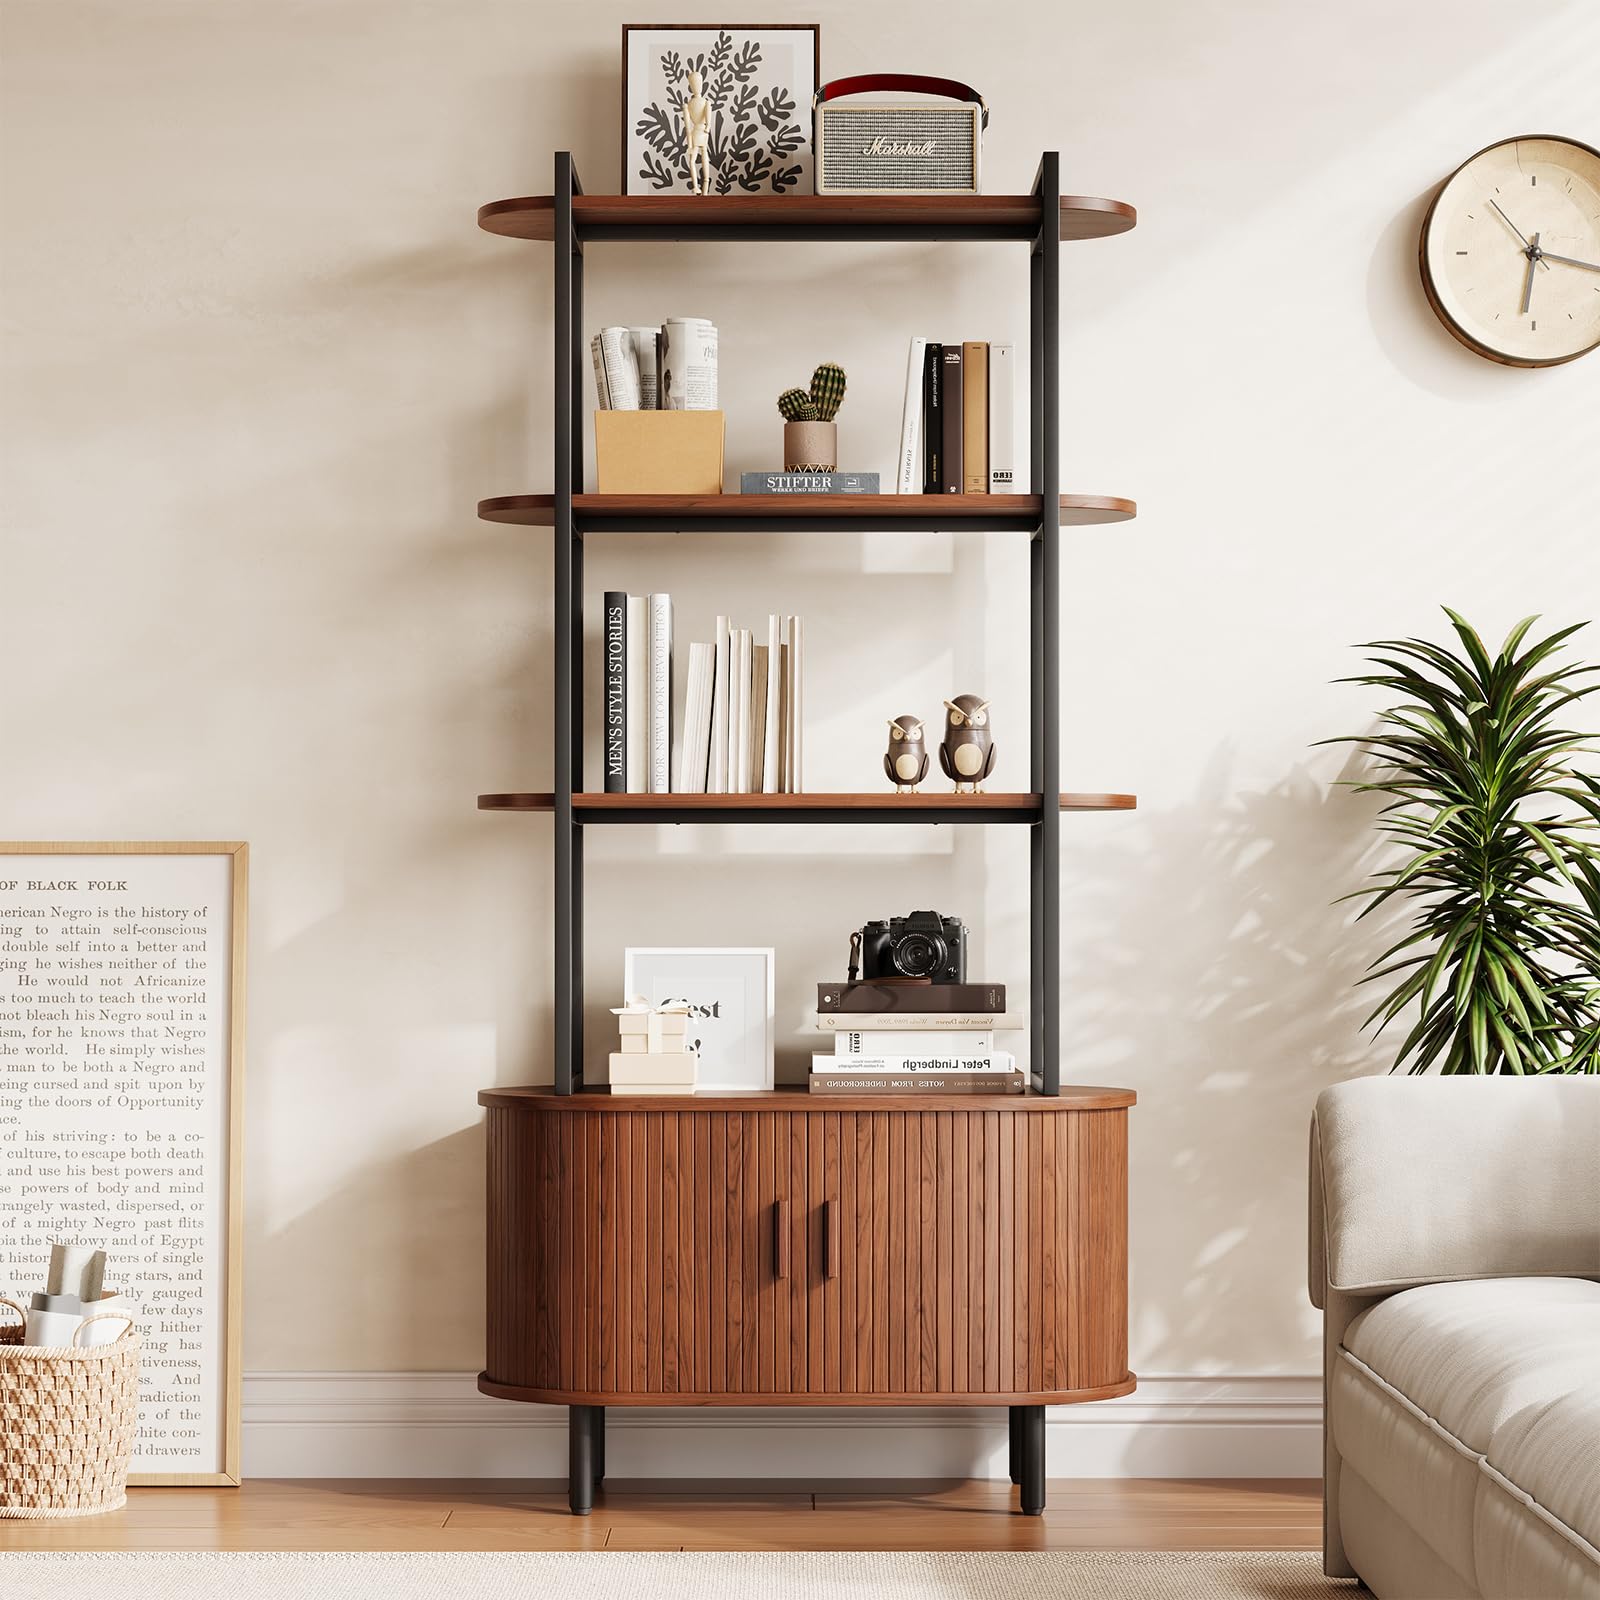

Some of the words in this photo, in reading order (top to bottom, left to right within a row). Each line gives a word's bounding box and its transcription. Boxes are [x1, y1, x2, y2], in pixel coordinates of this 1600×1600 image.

[863, 136, 936, 156] Marshall
[767, 477, 832, 488] STIFTER
[609, 606, 622, 674] STORIES
[656, 604, 665, 682] REVOLUTION
[609, 675, 622, 725] STYLE
[656, 686, 665, 720] LOOK
[609, 728, 622, 776] MEN'S
[0, 881, 18, 890] OF
[26, 880, 79, 891] BLACK
[88, 881, 128, 891] FOLK
[50, 904, 92, 921] Negro
[97, 906, 110, 918] is
[114, 906, 136, 918] the
[142, 905, 189, 921] history
[194, 904, 208, 918] of
[34, 924, 48, 935] to
[60, 924, 101, 935] attain
[113, 923, 207, 935] self-conscious
[2, 940, 48, 952] double
[56, 940, 80, 952] self
[88, 941, 115, 952] into
[137, 941, 178, 952] better
[182, 940, 206, 952] and
[36, 958, 51, 969] he
[57, 958, 103, 969] wishes
[109, 958, 157, 969] neither
[163, 958, 176, 969] of
[185, 958, 207, 969] the
[17, 975, 38, 986] He
[46, 975, 88, 986] would
[100, 976, 123, 986] not
[133, 975, 206, 986] Africanize
[10, 992, 32, 1003] too
[37, 992, 75, 1003] much
[80, 994, 93, 1003] to
[99, 992, 135, 1004] teach
[140, 992, 163, 1004] the
[166, 992, 207, 1004] world
[25, 1009, 69, 1021] bleach
[74, 1009, 95, 1021] his
[98, 1009, 141, 1024] Negro
[146, 1009, 175, 1021] soul
[180, 1010, 193, 1020] in
[32, 1025, 52, 1037] for
[57, 1026, 72, 1037] he
[81, 1026, 124, 1038] knows
[131, 1026, 159, 1038] that
[164, 1026, 206, 1041] Negro
[24, 1043, 68, 1055] world.
[86, 1043, 105, 1056] He
[110, 1044, 155, 1058] simply
[161, 1044, 205, 1055] wishes
[7, 1064, 35, 1072] man
[42, 1063, 55, 1072] to
[62, 1061, 78, 1072] be
[84, 1061, 113, 1072] both
[132, 1061, 175, 1076] Negro
[180, 1061, 205, 1072] and
[34, 1078, 79, 1089] cursed
[83, 1078, 109, 1089] and
[114, 1079, 140, 1093] spit
[149, 1082, 183, 1093] upon
[189, 1078, 205, 1093] by
[29, 1096, 50, 1107] the
[55, 1096, 92, 1107] doors
[98, 1096, 112, 1107] of
[118, 1095, 205, 1110] Opportunity
[4, 1130, 17, 1141] of
[25, 1130, 45, 1141] his
[124, 1132, 137, 1142] to
[146, 1130, 161, 1142] be
[7, 1148, 60, 1160] culture,
[65, 1149, 78, 1160] to
[82, 1151, 126, 1162] escape
[130, 1147, 161, 1159] both
[167, 1147, 204, 1159] death
[7, 1165, 32, 1176] and
[39, 1168, 61, 1176] use
[66, 1164, 86, 1176] his
[90, 1165, 120, 1176] best
[125, 1168, 173, 1179] powers
[179, 1165, 204, 1176] and
[21, 1185, 69, 1196] powers
[75, 1182, 88, 1193] of
[97, 1182, 129, 1196] body
[135, 1182, 160, 1193] and
[169, 1182, 204, 1193] mind
[60, 1199, 110, 1213] wasted,
[116, 1199, 184, 1214] dispersed,
[190, 1203, 204, 1211] or
[2, 1217, 16, 1228] of
[37, 1217, 87, 1232] mighty
[93, 1217, 136, 1232] Negro
[144, 1218, 173, 1231] past
[179, 1217, 204, 1228] flits
[21, 1234, 42, 1246] the
[45, 1234, 108, 1249] Shadowy
[112, 1234, 137, 1246] and
[141, 1234, 155, 1246] of
[160, 1234, 204, 1249] Egypt
[9, 1252, 50, 1264] histor
[144, 1251, 158, 1263] of
[163, 1252, 203, 1267] single
[9, 1269, 44, 1281] there
[136, 1271, 172, 1282] stars,
[178, 1269, 203, 1280] and
[152, 1286, 203, 1302] gauged
[141, 1304, 166, 1315] few
[171, 1304, 203, 1318] days
[160, 1321, 203, 1333] hither
[180, 1339, 202, 1350] has
[137, 1356, 201, 1370] tiveness,
[171, 1374, 200, 1384] And
[156, 1408, 170, 1420] of
[180, 1409, 201, 1420] the
[172, 1429, 200, 1438] con-
[146, 1444, 200, 1456] drawers
